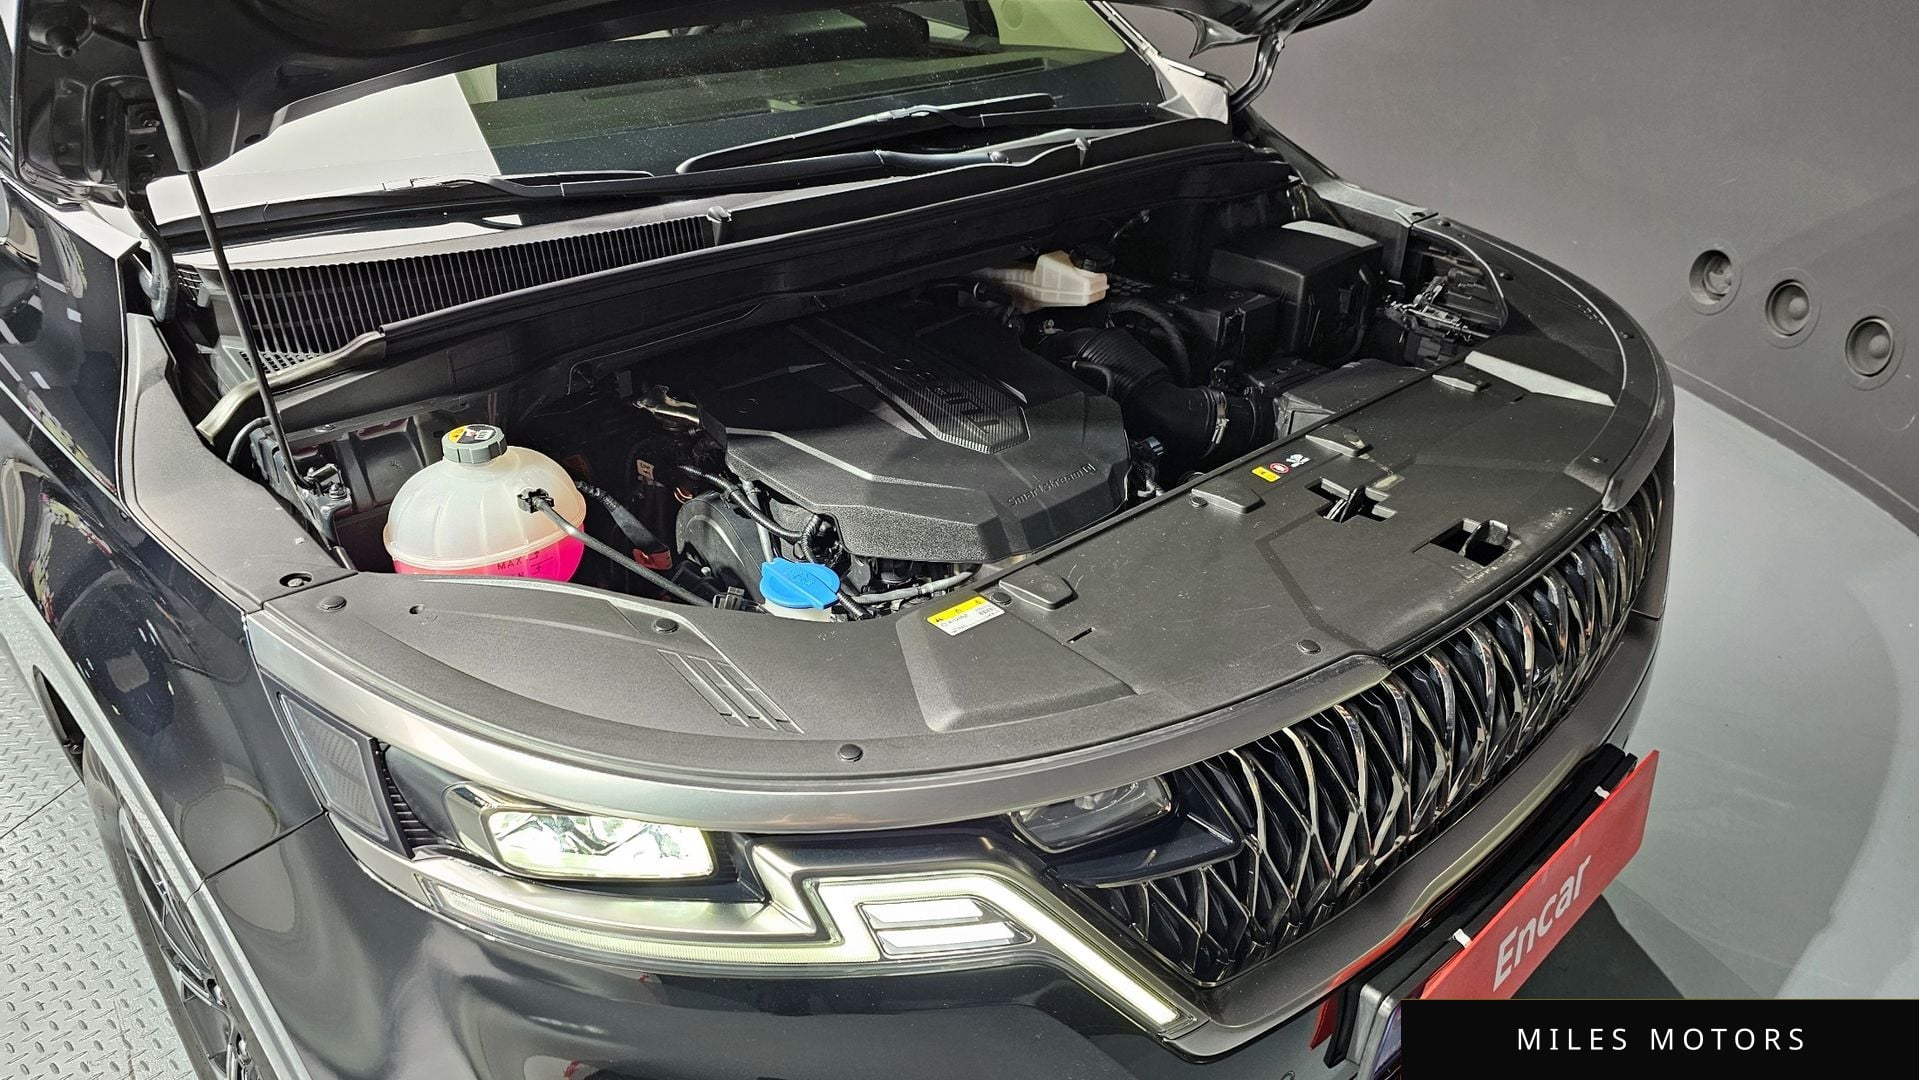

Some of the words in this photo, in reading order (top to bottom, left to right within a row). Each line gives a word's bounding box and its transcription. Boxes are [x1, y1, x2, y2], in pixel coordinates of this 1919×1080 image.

[1008, 469, 1084, 508] Smartstream
[497, 556, 522, 571] MAX
[1492, 854, 1592, 993] Encar
